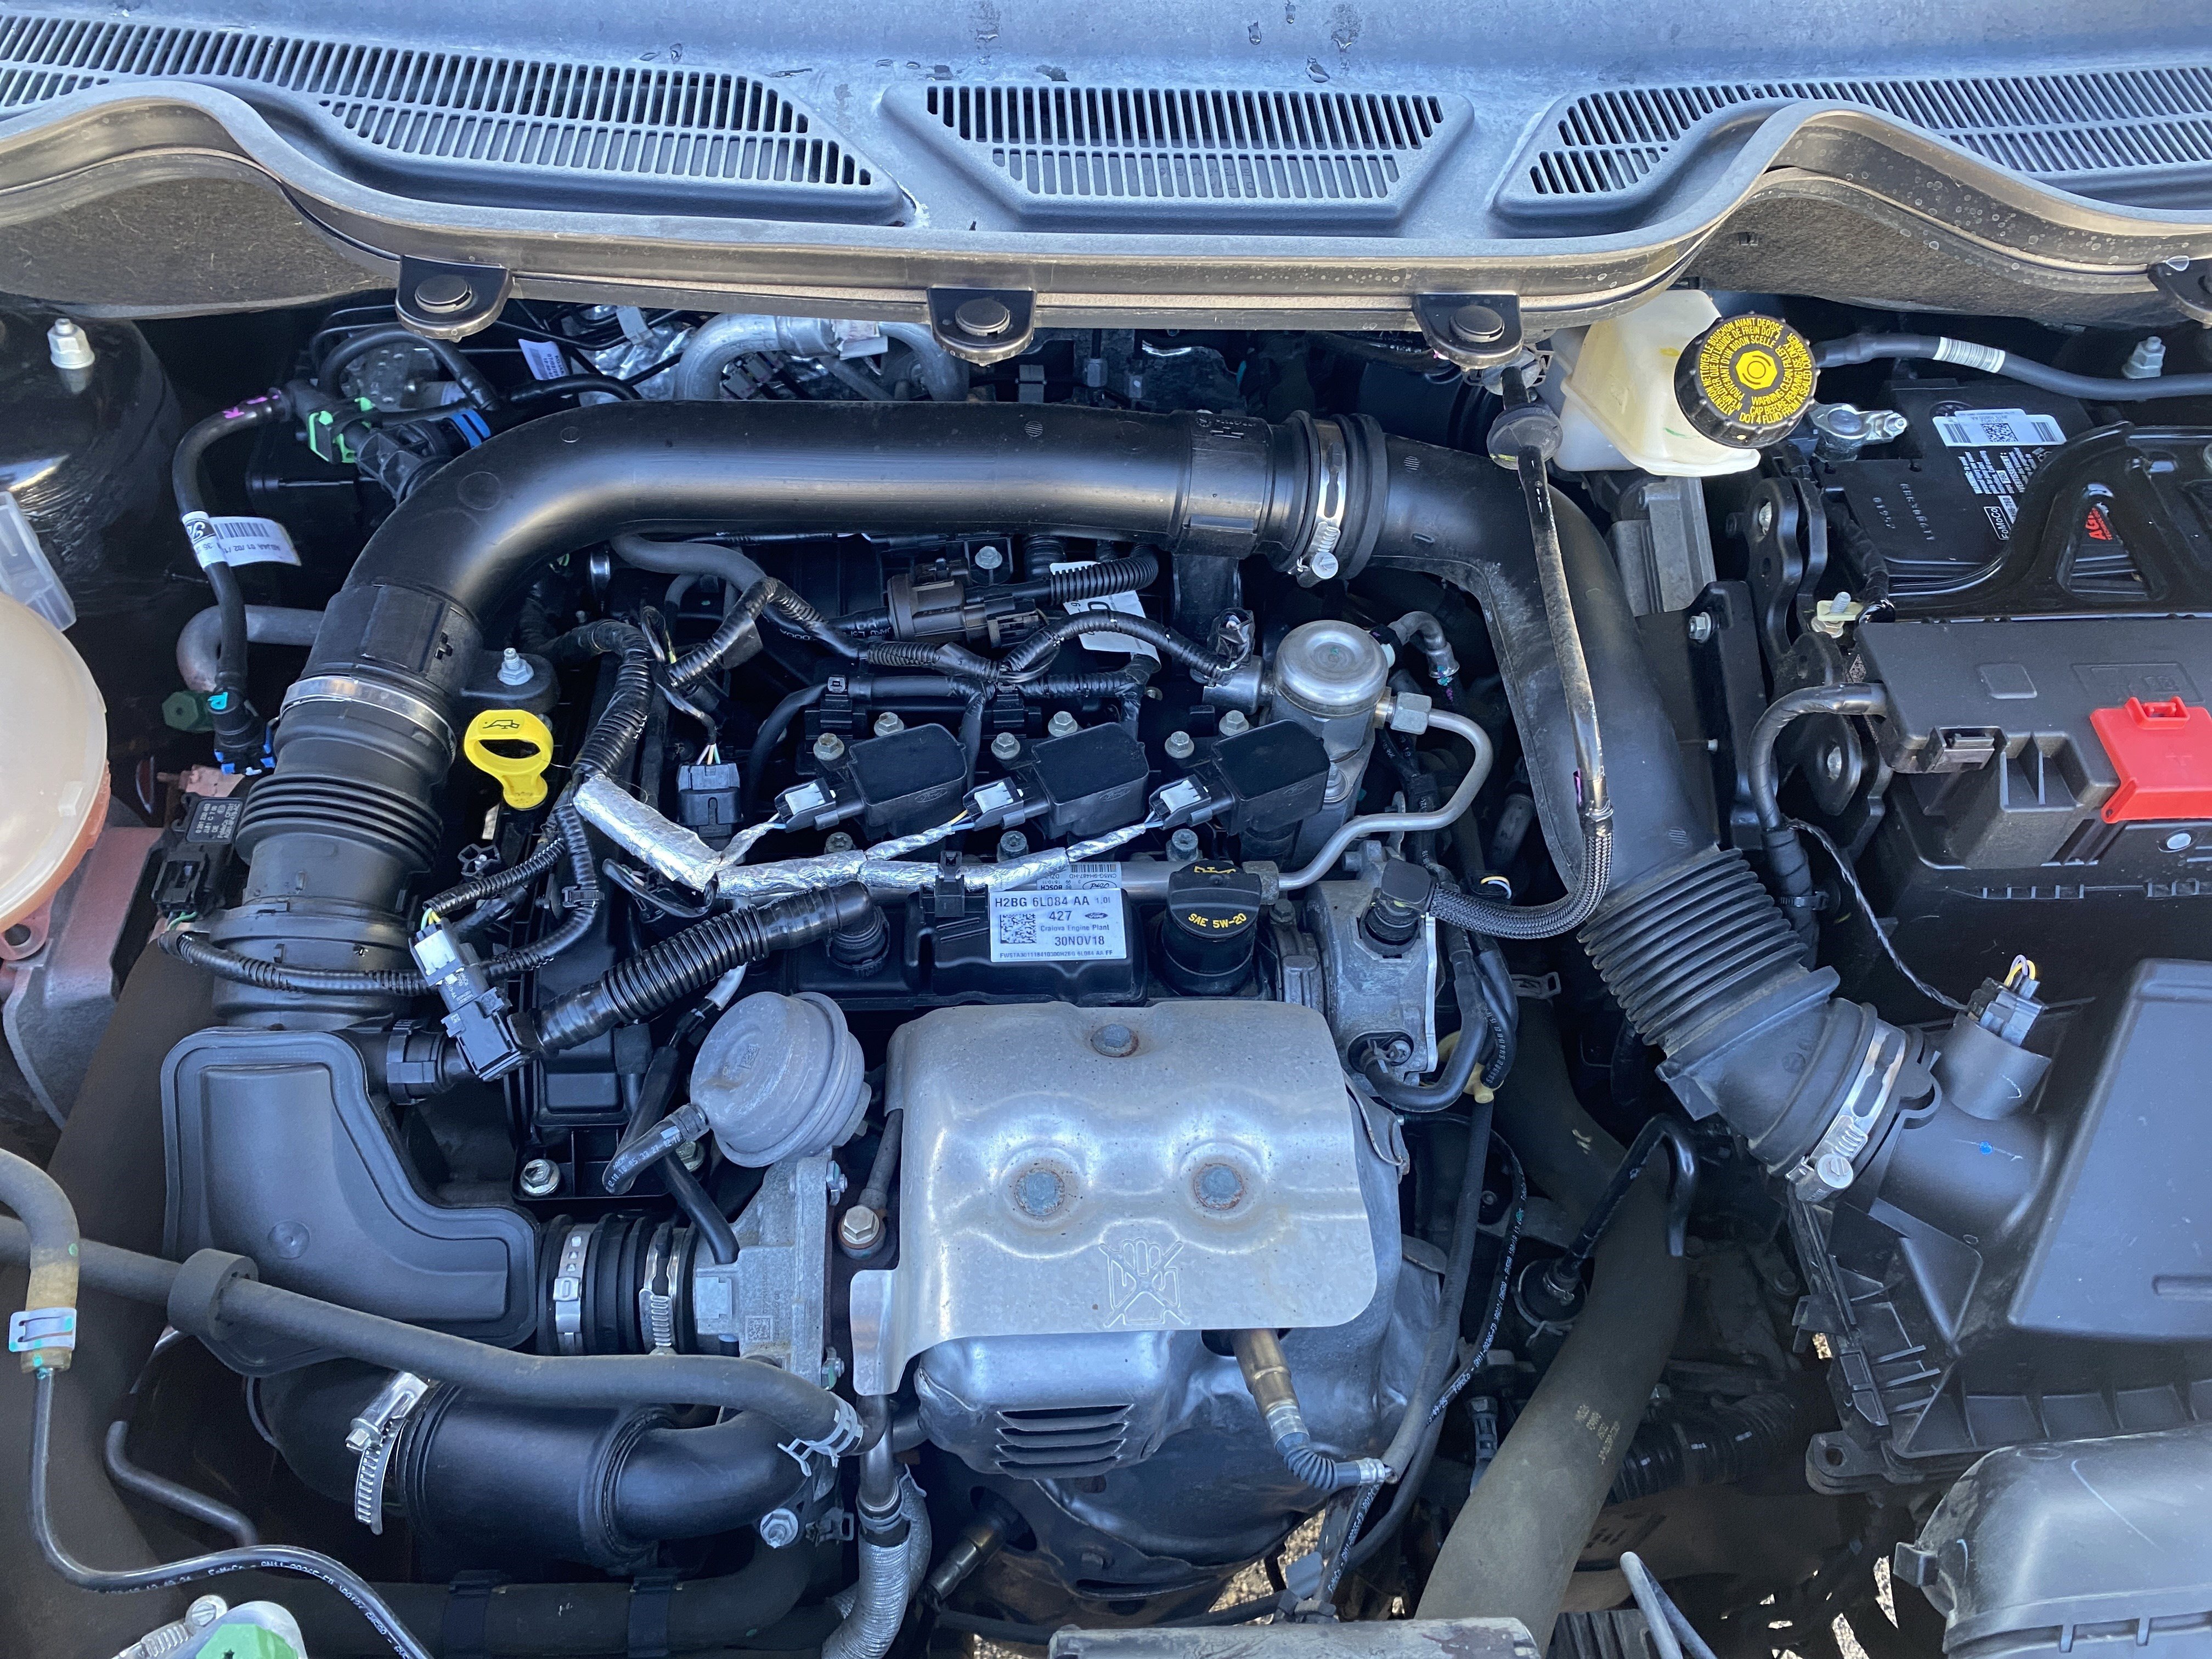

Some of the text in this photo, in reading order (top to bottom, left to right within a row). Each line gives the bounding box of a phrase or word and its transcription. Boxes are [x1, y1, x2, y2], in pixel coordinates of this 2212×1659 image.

[1731, 328, 1742, 338] DE
[1741, 326, 1759, 335] FREIN
[1761, 327, 1775, 337] DOT
[1713, 333, 1734, 354] LIQUIDE
[1729, 336, 1750, 351] BIDON
[1750, 335, 1776, 348] SCELLE
[1787, 333, 1812, 369] CONTAINER
[1710, 353, 1720, 363] DU
[1700, 318, 1784, 416] ATTENTION NETTOYER LE BOUCHON AVANT DEPOSE
[1709, 364, 1719, 377] QUE
[1720, 365, 1745, 400] PROVENANT
[1750, 342, 1803, 415] CAP BEFORE REMOVING USE ONLY
[1799, 370, 1812, 396] SEALED
[1751, 388, 1785, 405] WARNING
[1780, 369, 1793, 391] CLEAN
[1781, 399, 1801, 417] FROM
[1739, 412, 1756, 424] DOT
[1756, 415, 1762, 425] 4
[1762, 412, 1782, 425] FLUID
[995, 897, 1028, 907] H2BG
[1032, 896, 1068, 907] 6L084
[1074, 896, 1090, 905] AA
[1049, 911, 1072, 921] 427
[1188, 913, 1247, 929] SAE 5W-20
[1054, 935, 1105, 946] 30NOV18
